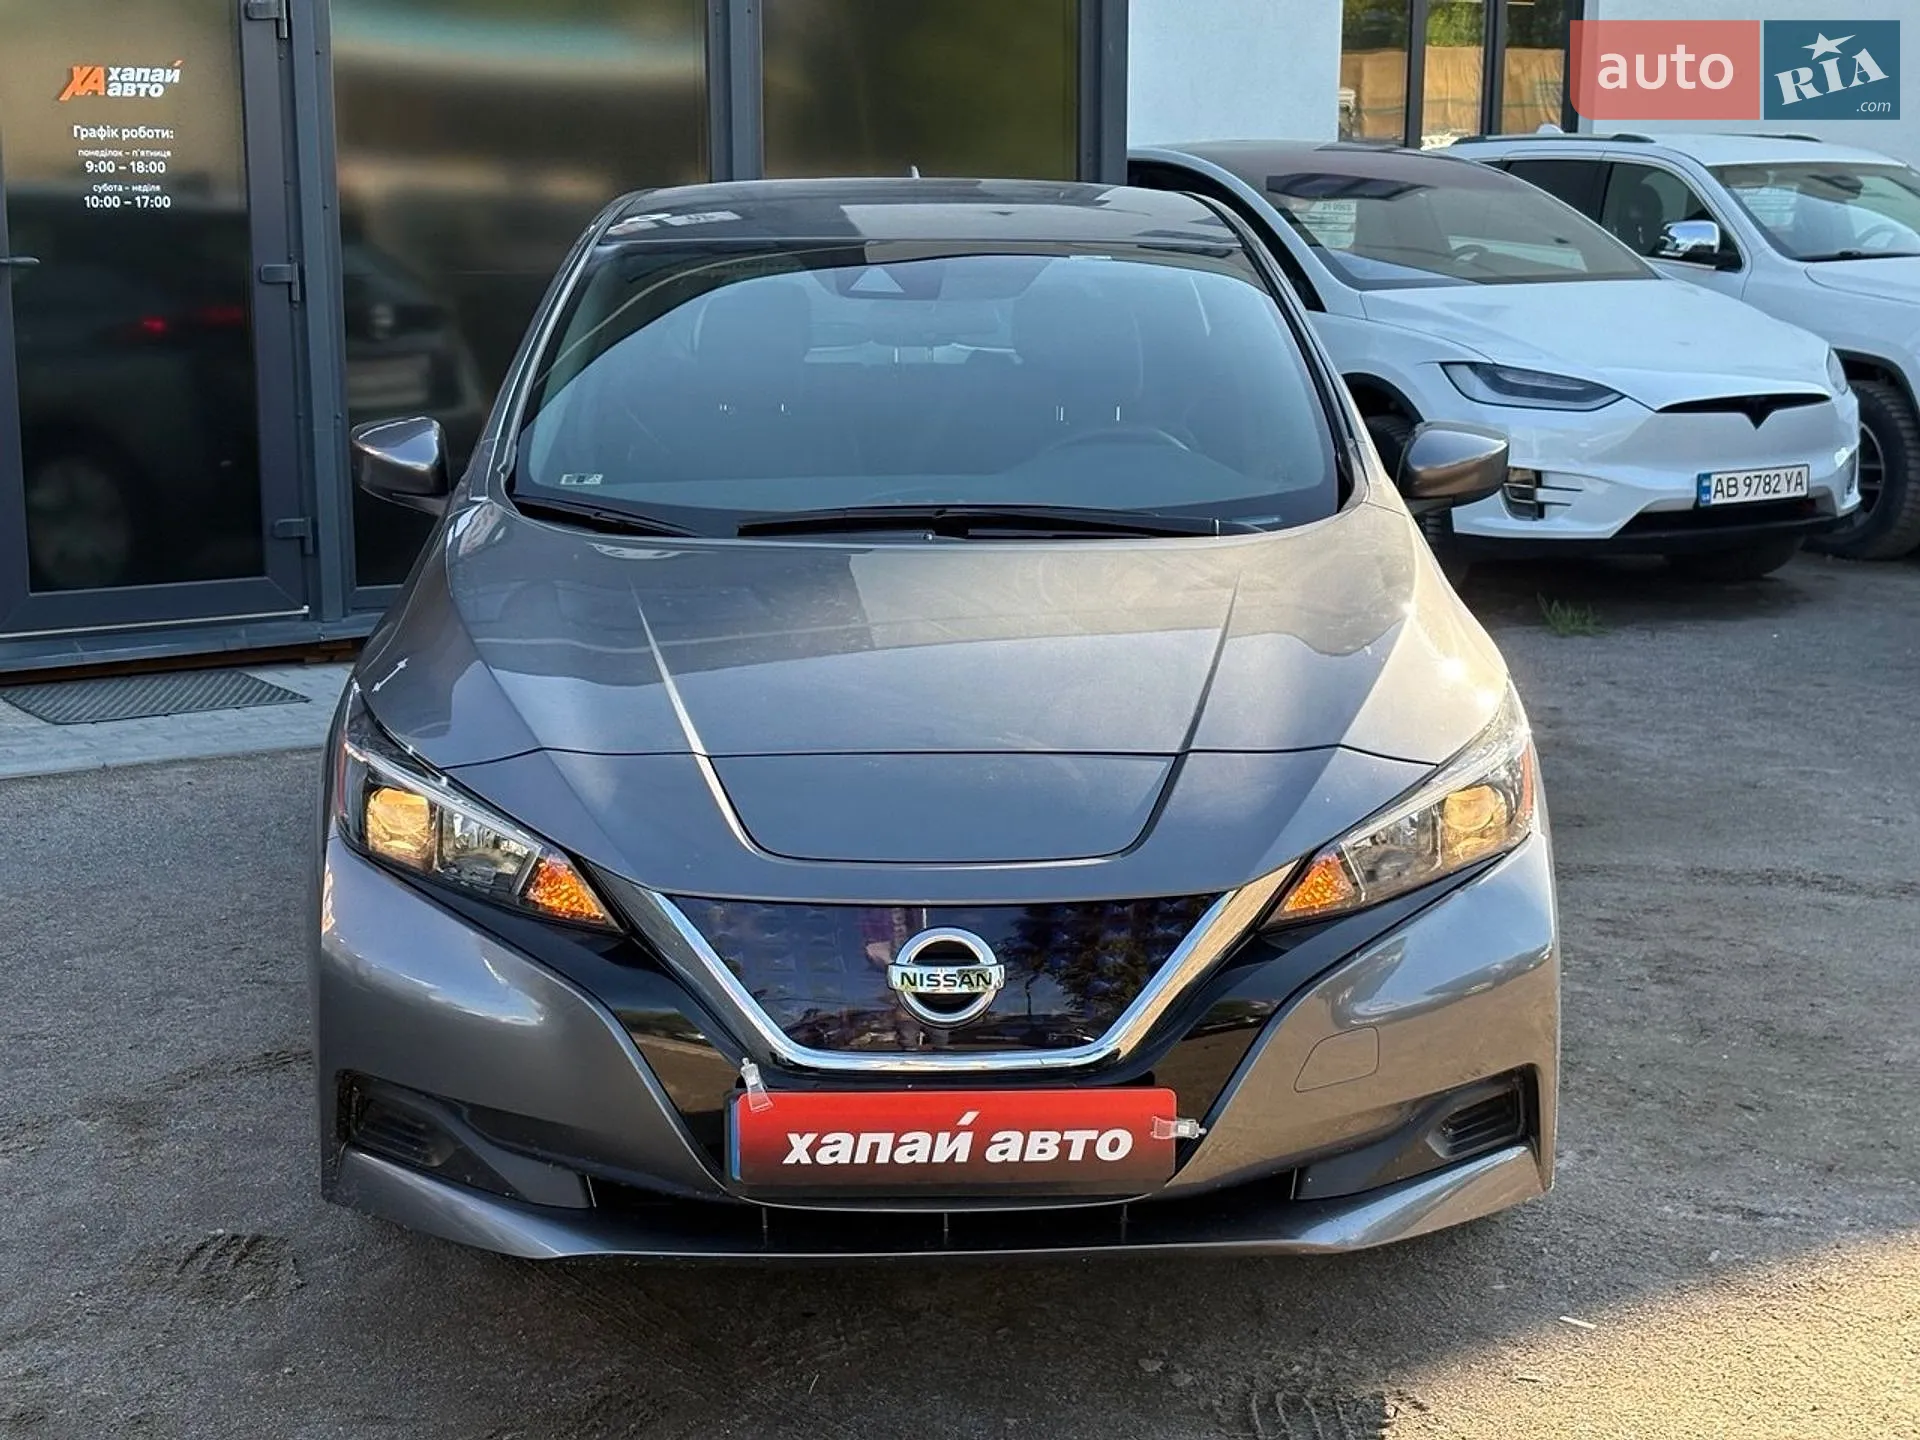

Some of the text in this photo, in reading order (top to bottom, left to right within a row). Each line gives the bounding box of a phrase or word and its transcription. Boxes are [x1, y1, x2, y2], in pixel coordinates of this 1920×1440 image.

[107, 83, 164, 98] авто
[73, 125, 174, 141] Графік роботи:
[78, 148, 123, 158] понеділок
[85, 160, 116, 174] 9:00
[129, 160, 166, 174] 18:00
[92, 183, 123, 193] субота
[131, 183, 161, 193] неділя
[84, 195, 121, 209] 10:00
[135, 195, 171, 209] 17:00
[1713, 470, 1804, 499] AB 9782 YA
[900, 971, 992, 988] NISSAN
[782, 1110, 1134, 1165] хапай авто
